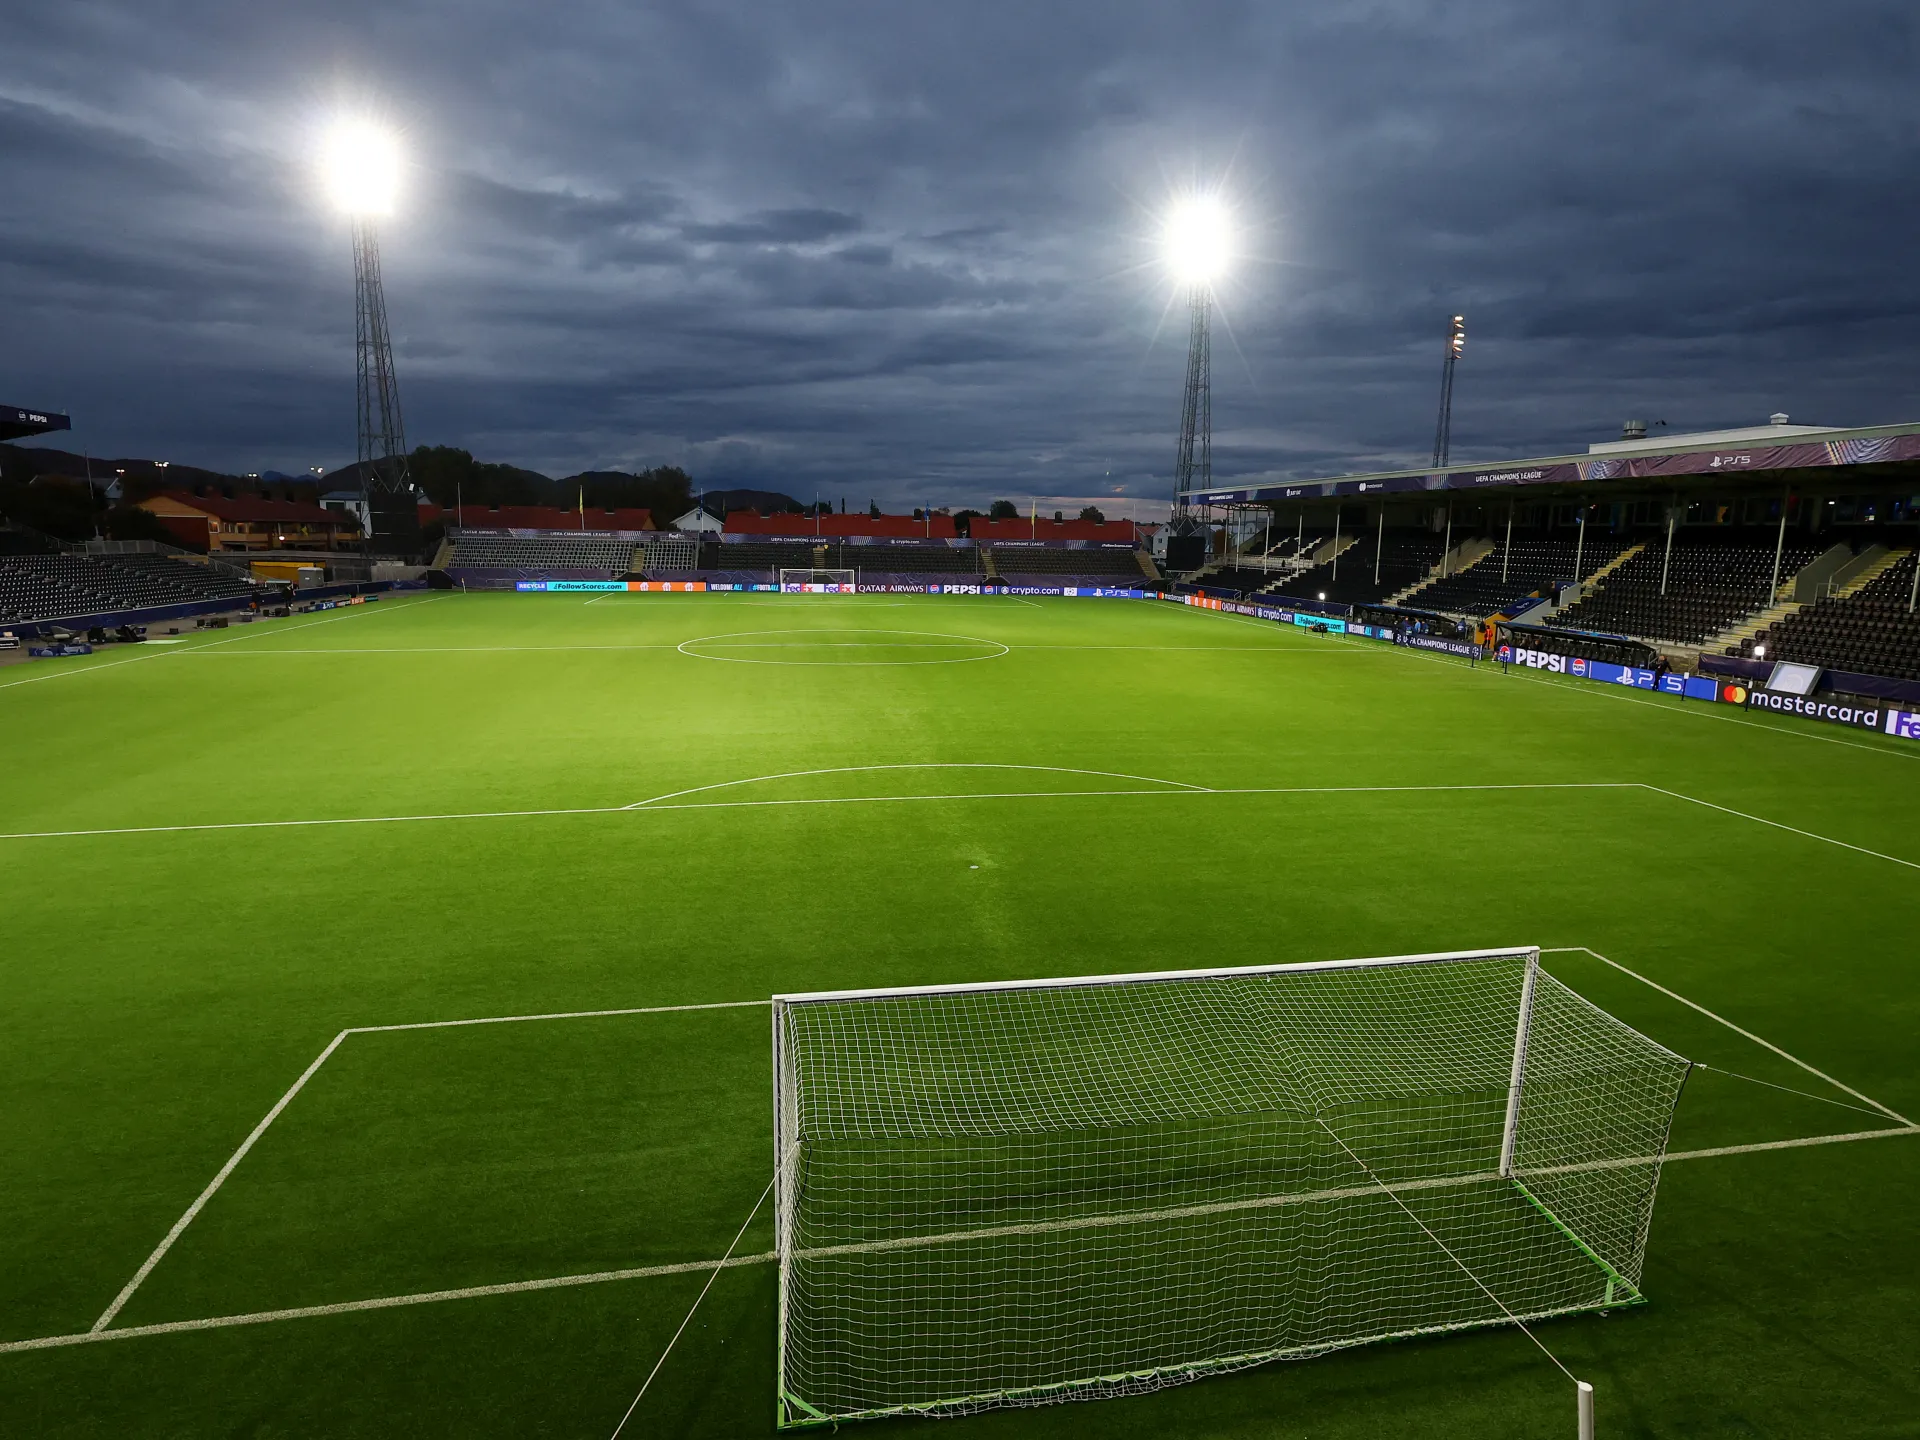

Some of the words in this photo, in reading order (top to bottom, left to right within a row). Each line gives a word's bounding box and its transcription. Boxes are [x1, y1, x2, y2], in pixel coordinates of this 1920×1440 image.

[29, 413, 47, 423] PEPSI
[1723, 455, 1750, 465] PS5
[1489, 472, 1519, 482] CHAMPIONS
[1520, 471, 1542, 479] LEAGUE
[785, 584, 814, 592] FedEx
[824, 584, 852, 593] FedEx
[858, 584, 886, 593] QATAR
[889, 584, 924, 593] AIRWAYS
[943, 584, 980, 594] PEPSI
[1011, 587, 1060, 596] crypto.com
[1104, 589, 1129, 597] PS5
[1221, 602, 1236, 612] QATAR
[1236, 604, 1255, 616] AIRWAYS
[1263, 608, 1293, 623] cryptocom
[1403, 635, 1416, 645] UFA
[1416, 638, 1448, 650] CHAMPIONS
[1448, 643, 1471, 654] LEAGUE
[1516, 648, 1566, 674] PEPSI
[1751, 691, 1878, 727] mastercard
